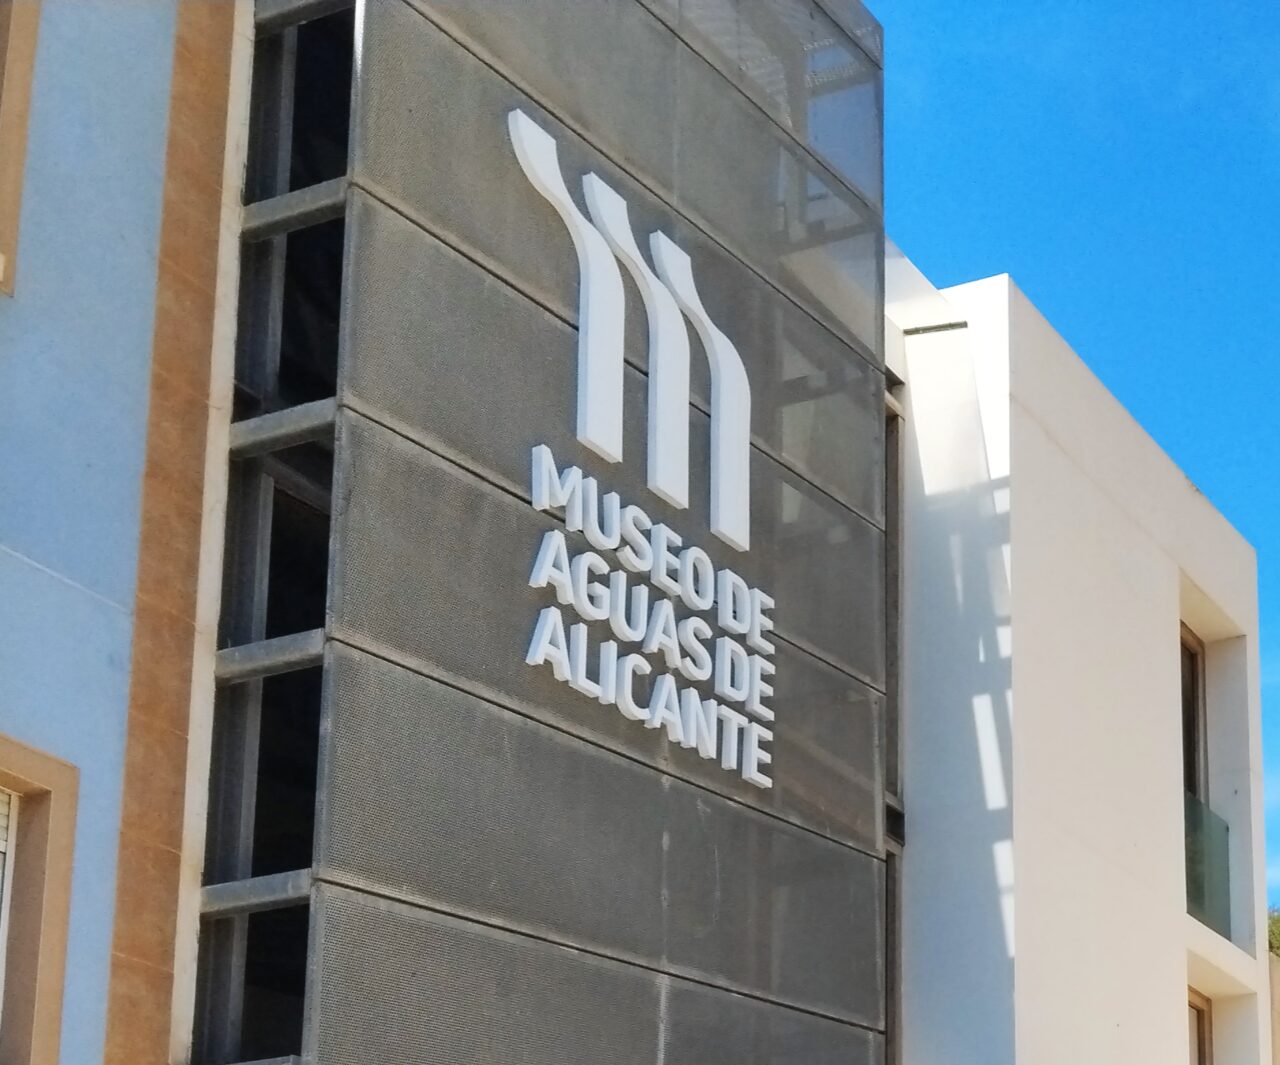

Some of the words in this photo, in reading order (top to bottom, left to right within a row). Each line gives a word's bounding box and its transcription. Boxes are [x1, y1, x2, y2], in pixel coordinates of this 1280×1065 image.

[528, 529, 713, 681] AGUAS
[714, 636, 776, 722] DE
[531, 443, 714, 611] MUSEO
[717, 568, 775, 655] DE
[525, 605, 773, 789] ALICANTE
